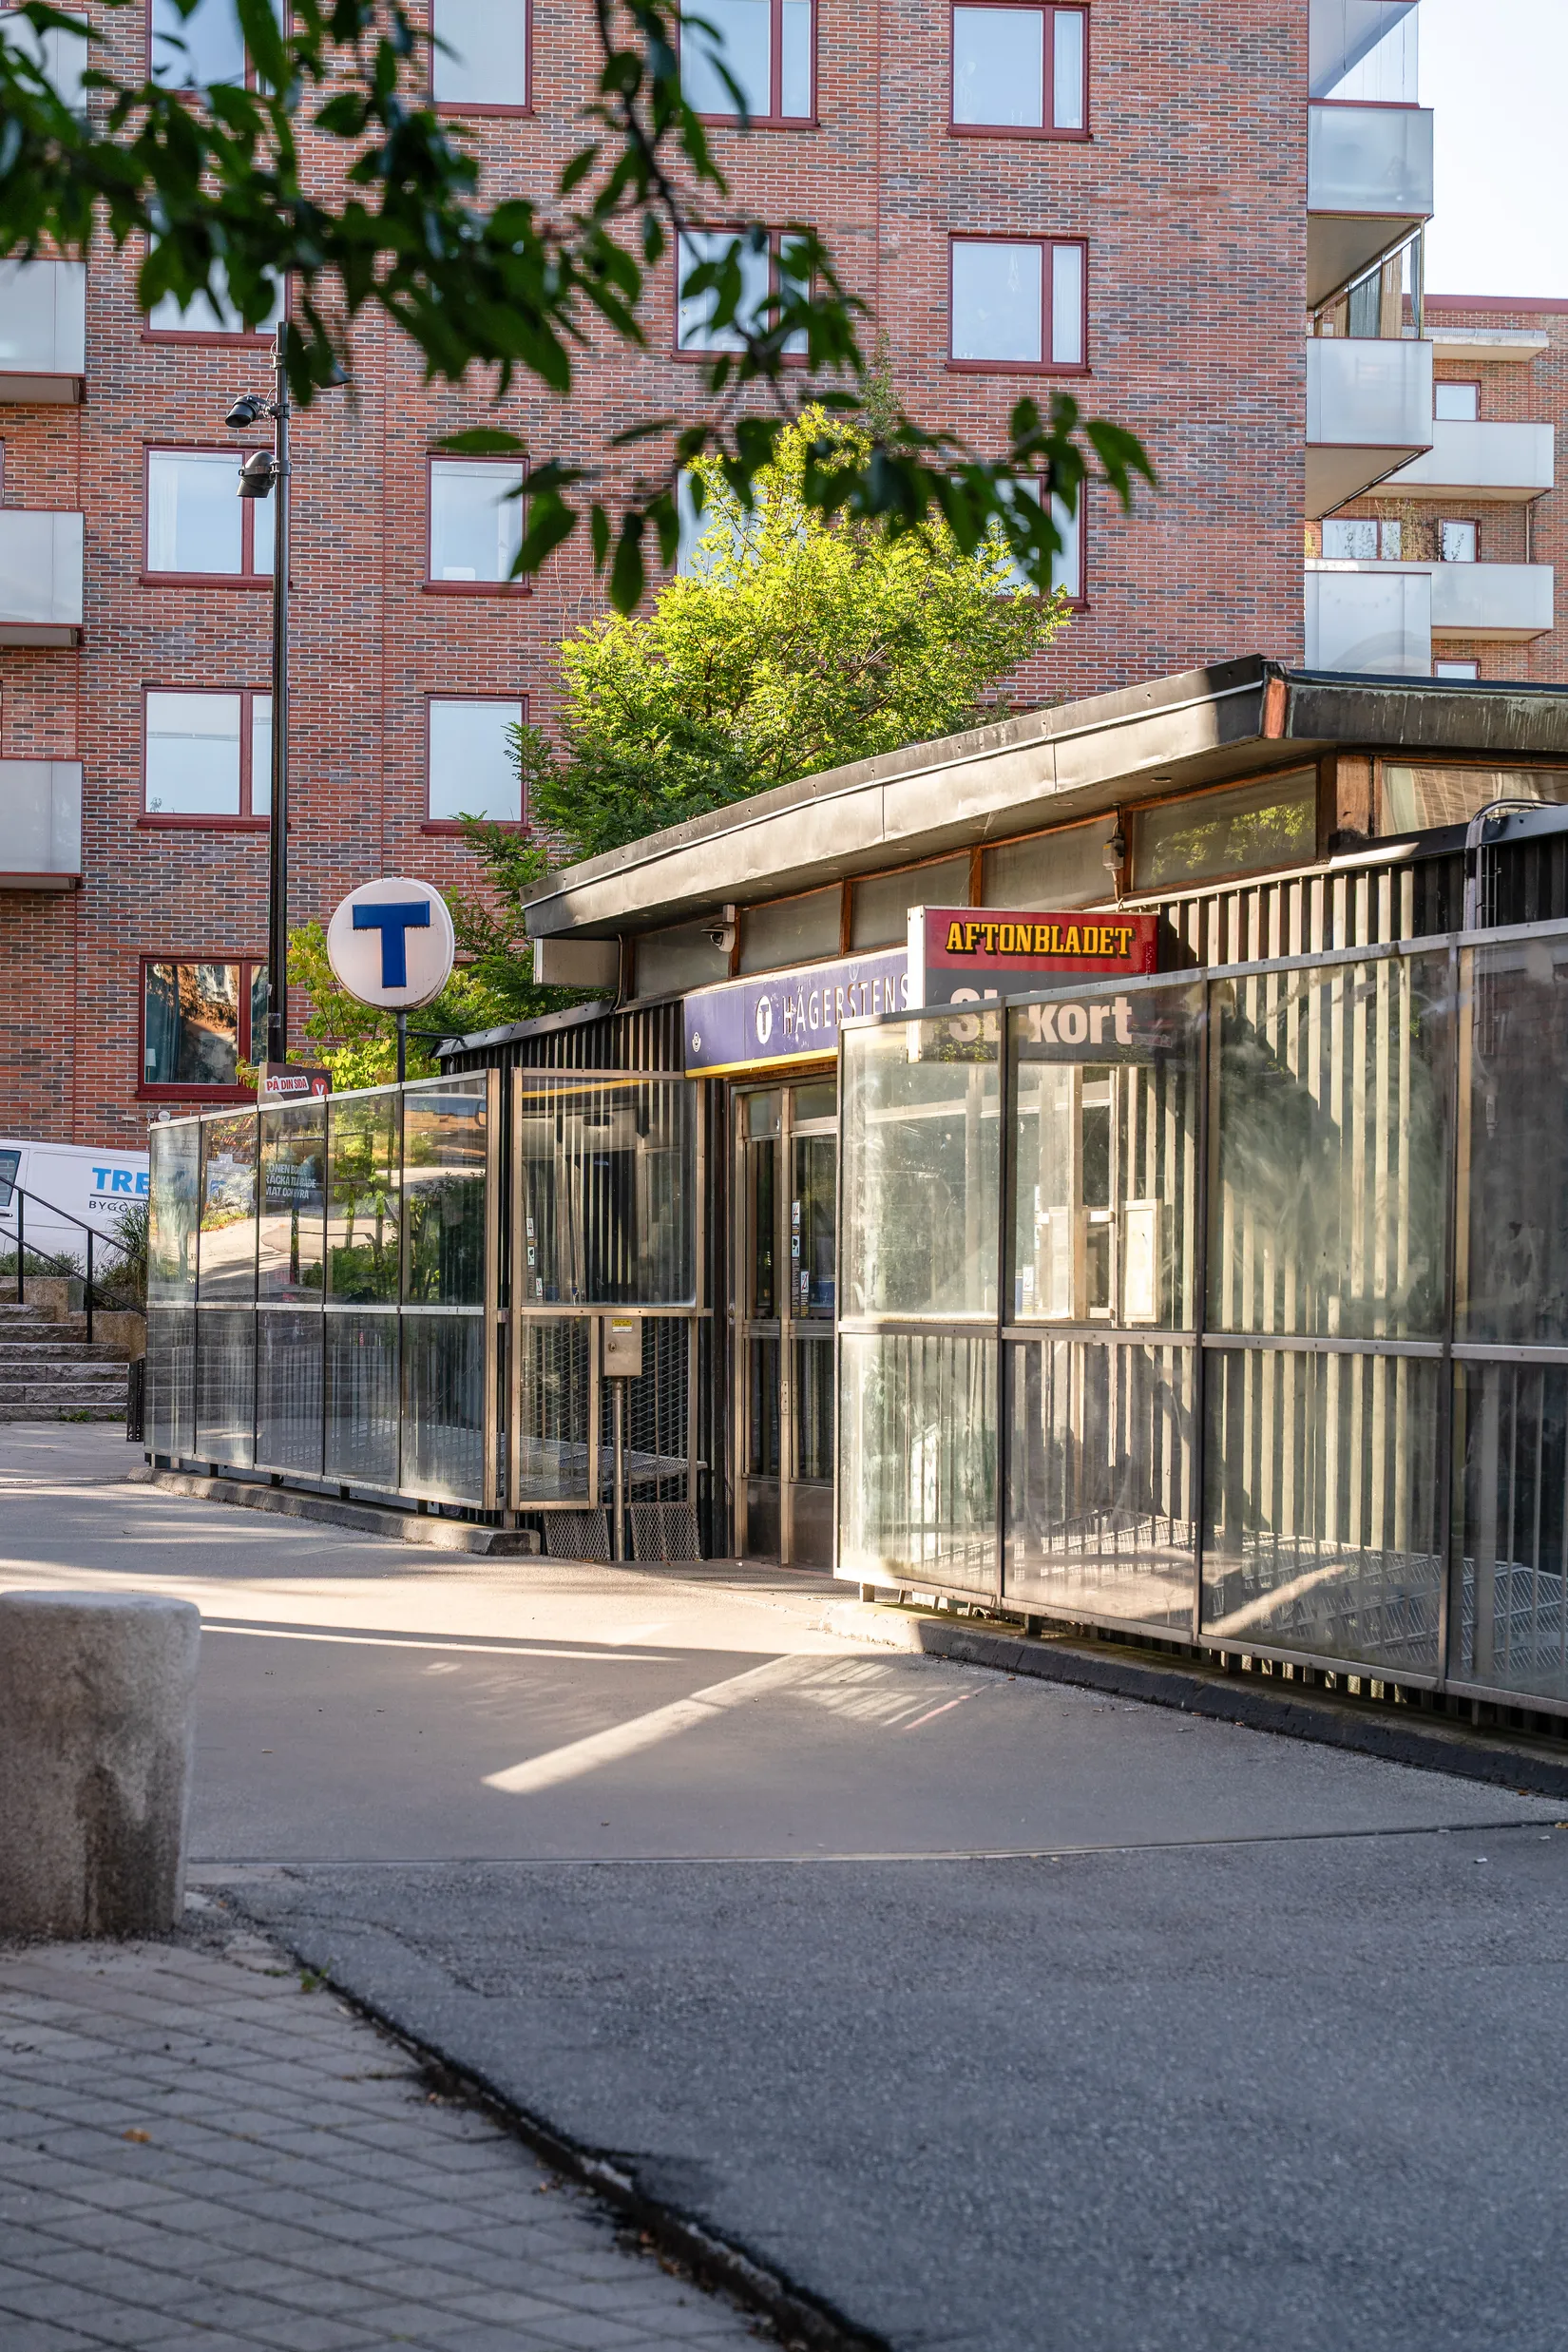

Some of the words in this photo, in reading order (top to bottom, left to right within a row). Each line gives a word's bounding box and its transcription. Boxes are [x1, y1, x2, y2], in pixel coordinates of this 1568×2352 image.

[353, 901, 430, 988] T
[946, 922, 1134, 957] AFTONBLADET
[266, 1078, 279, 1091] PÅ
[280, 1079, 294, 1090] DIN
[294, 1078, 308, 1090] SIDA
[316, 1083, 325, 1096] V
[92, 1167, 149, 1195] TRE
